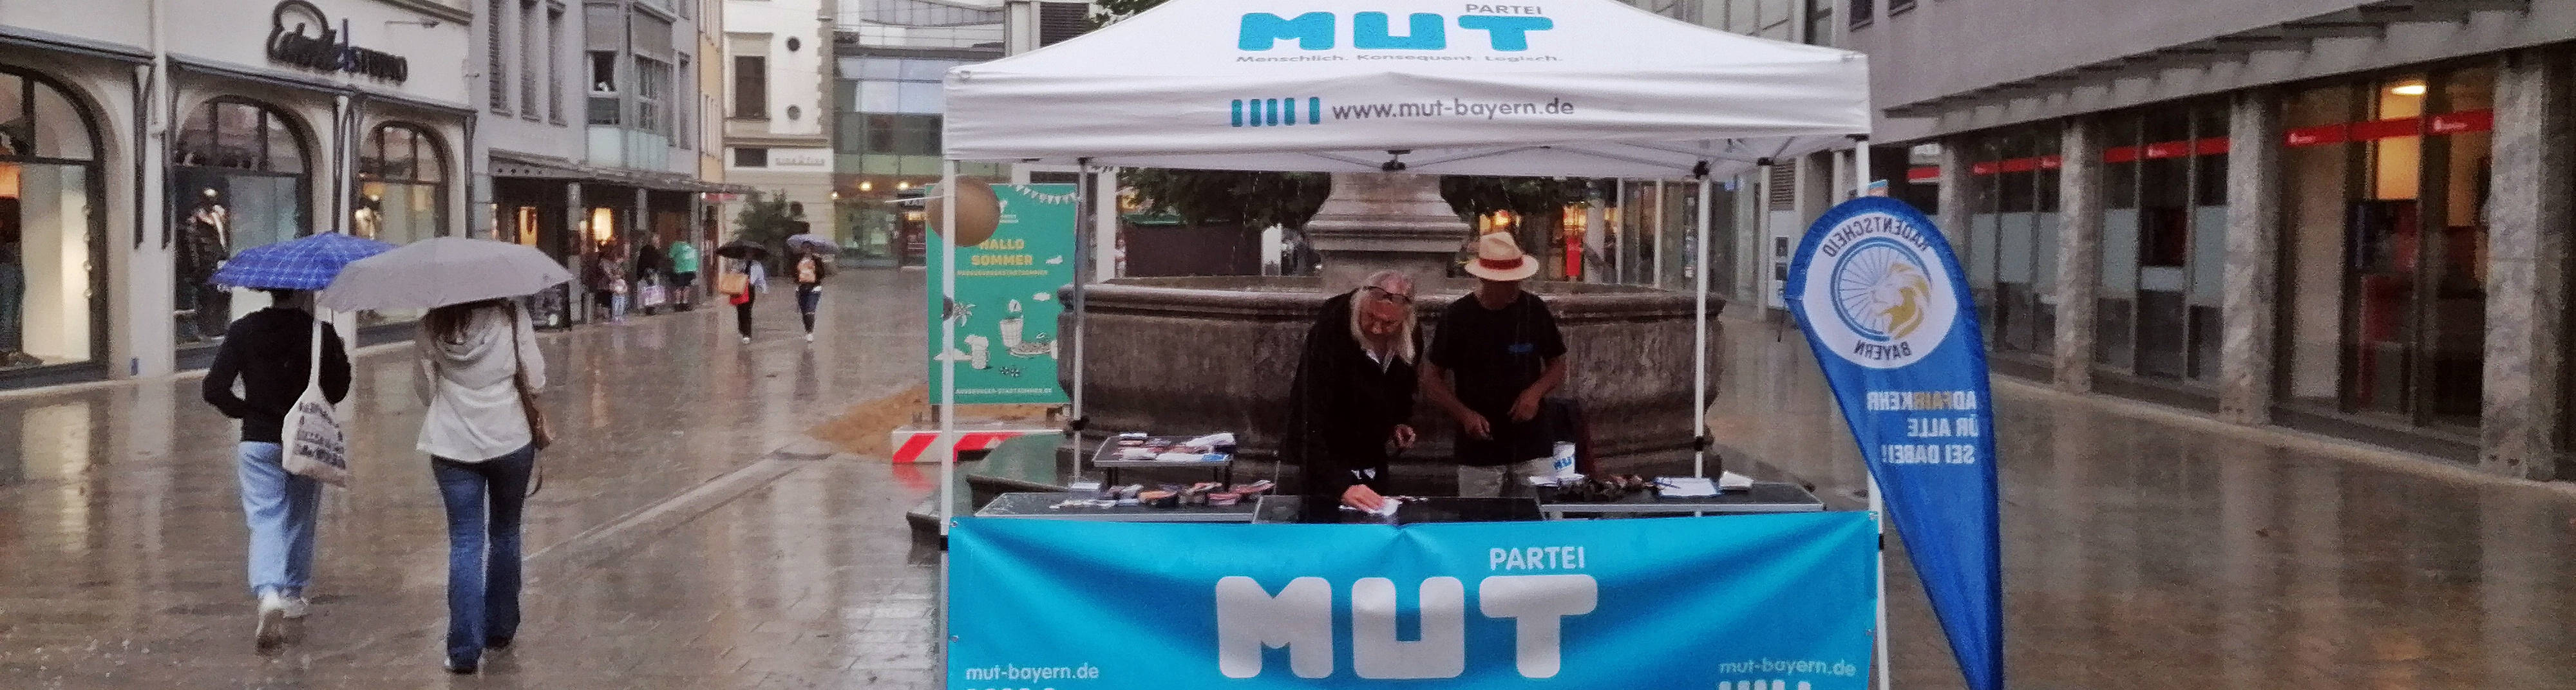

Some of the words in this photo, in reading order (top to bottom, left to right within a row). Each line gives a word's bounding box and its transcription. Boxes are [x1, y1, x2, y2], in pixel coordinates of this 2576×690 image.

[1466, 3, 1542, 15] PARTEI
[1238, 11, 1554, 51] MUT
[1332, 97, 1574, 119] www.mut-bayern.de
[1489, 546, 1585, 570] PARTEI
[1215, 574, 1598, 678] MUT
[966, 662, 1099, 684] mut-bayern.de
[1719, 657, 1856, 676] mut-bayern.de
